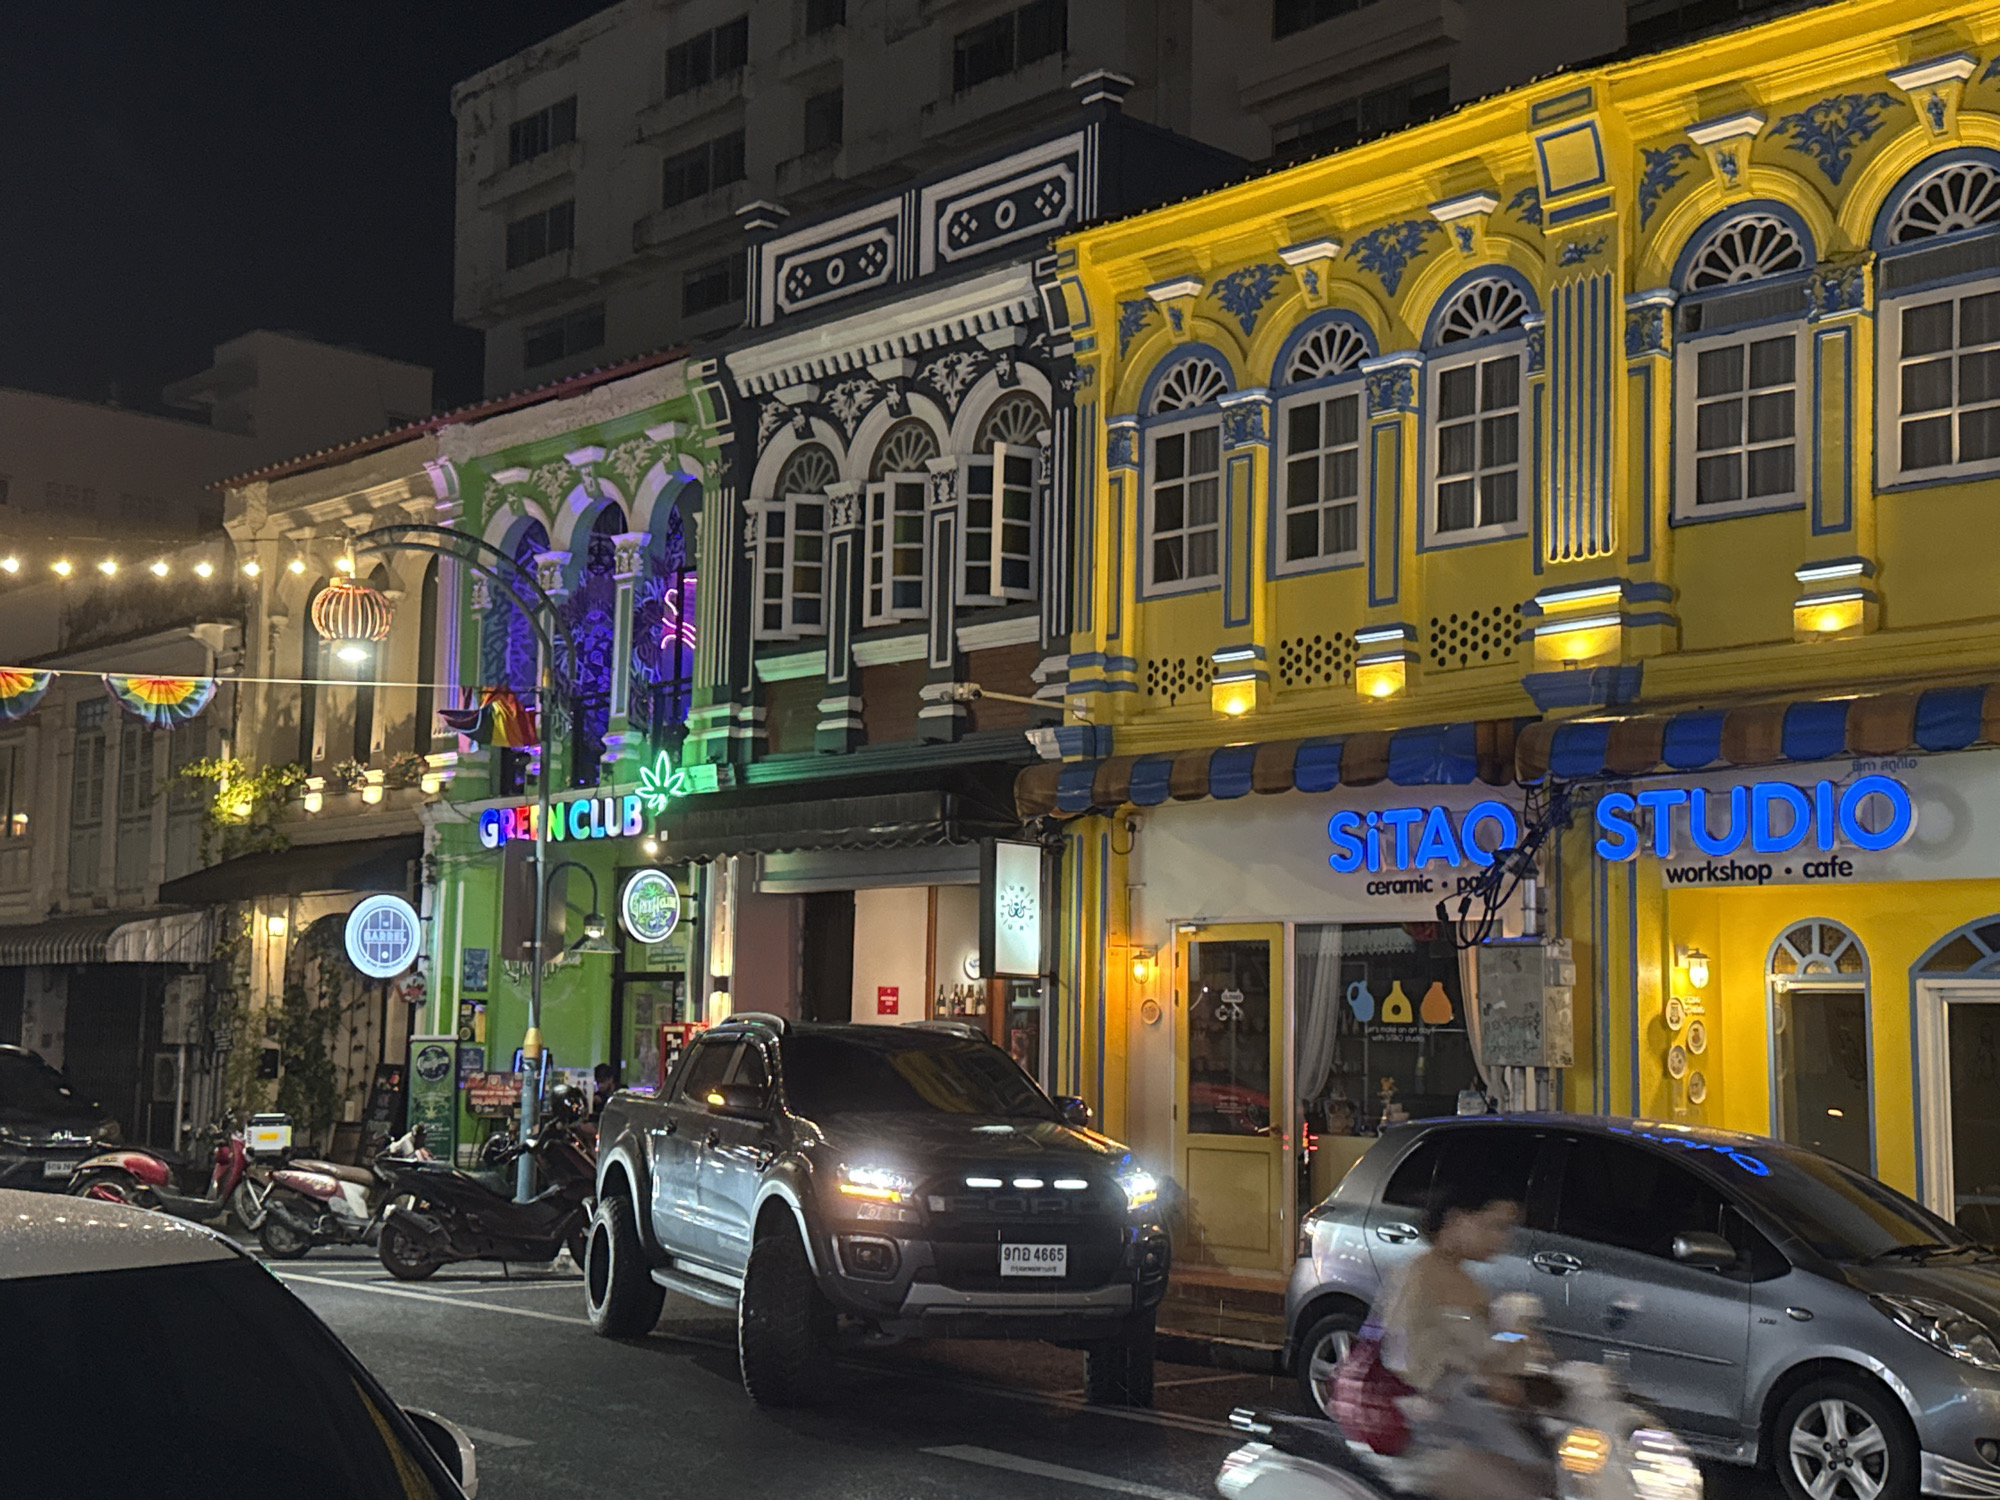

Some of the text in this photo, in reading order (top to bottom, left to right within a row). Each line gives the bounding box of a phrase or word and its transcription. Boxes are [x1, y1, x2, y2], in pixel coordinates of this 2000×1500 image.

[478, 795, 643, 848] GREEN CLUB
[1595, 774, 1912, 861] STUDIO
[1328, 800, 1518, 873] SiTAO
[1366, 874, 1433, 895] ceramic
[1666, 855, 1853, 885] workshop cafe
[364, 931, 407, 942] BARREL
[1034, 1247, 1064, 1262] 4665
